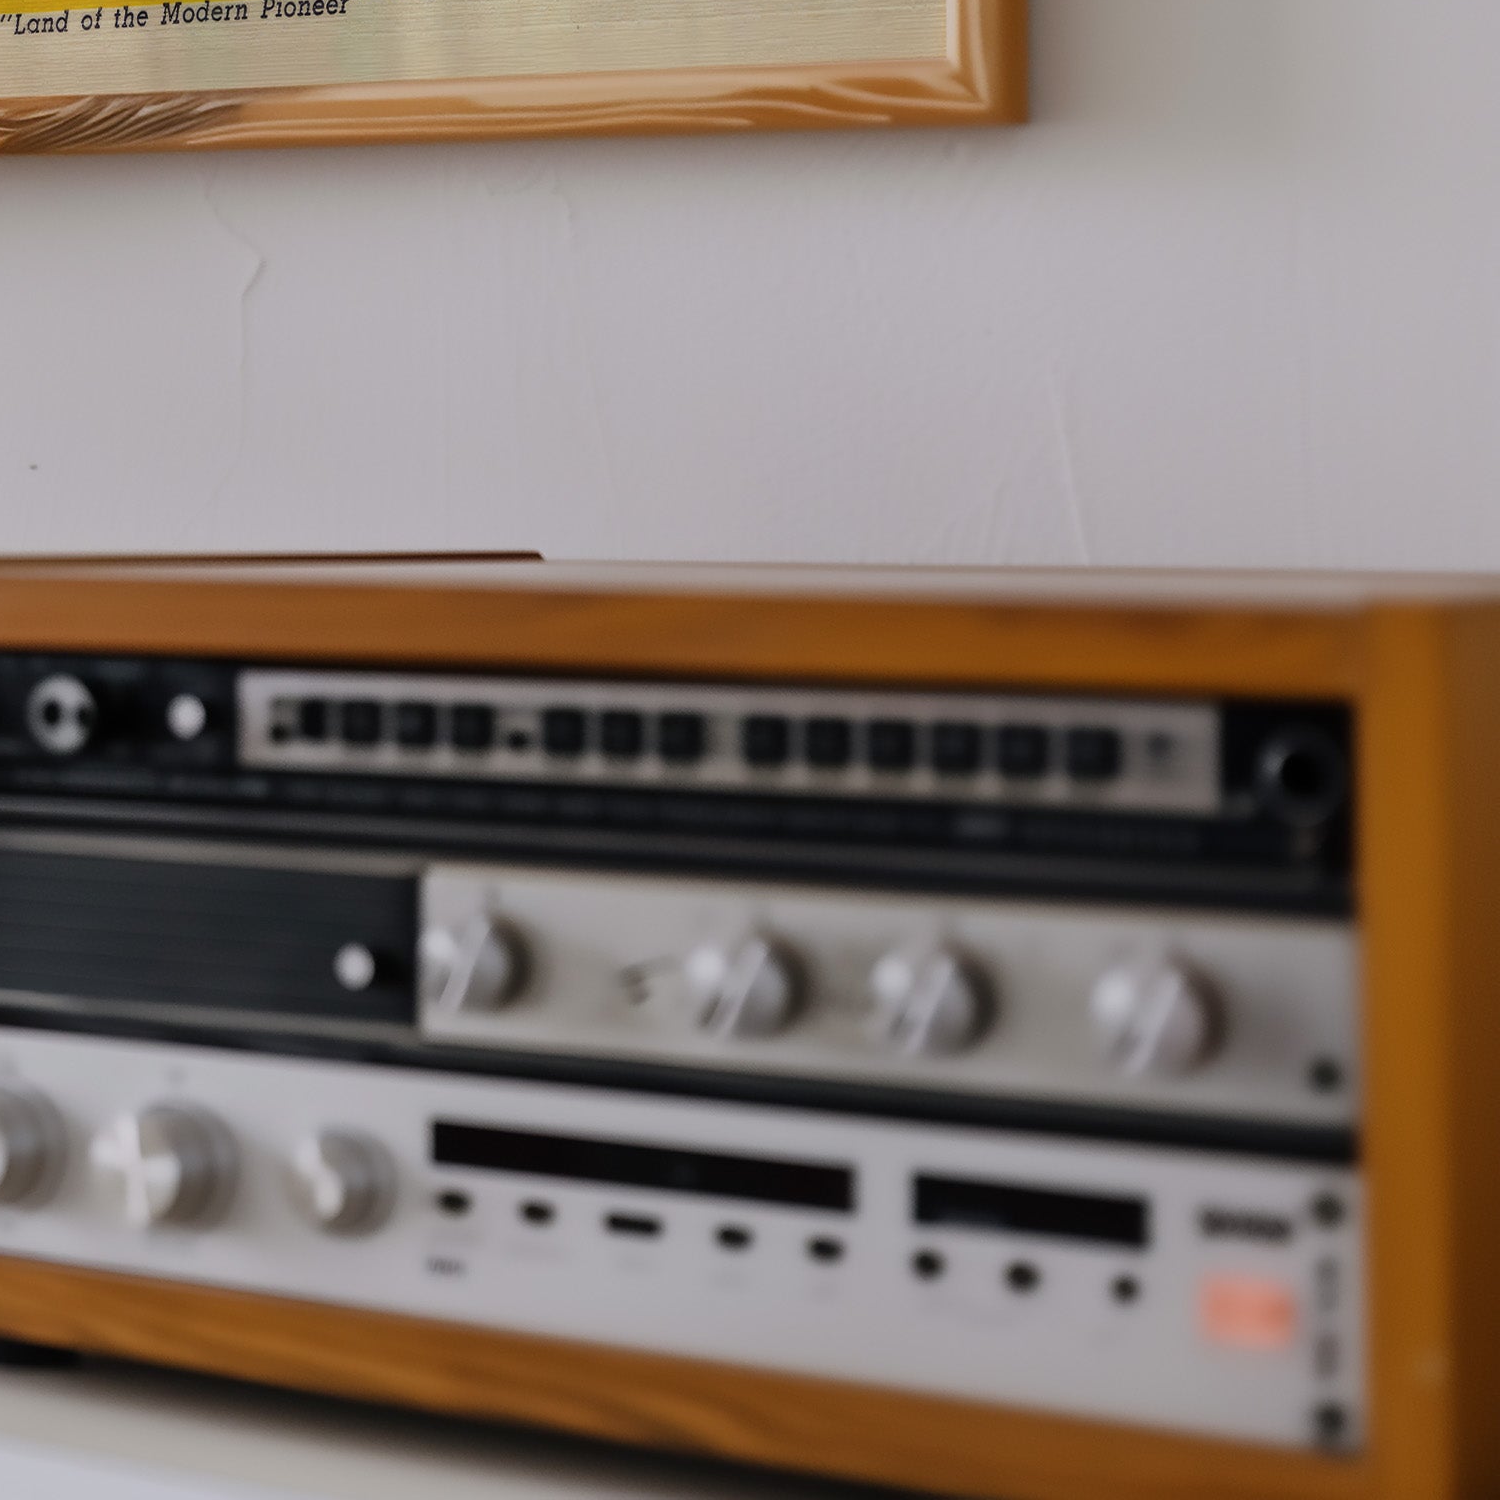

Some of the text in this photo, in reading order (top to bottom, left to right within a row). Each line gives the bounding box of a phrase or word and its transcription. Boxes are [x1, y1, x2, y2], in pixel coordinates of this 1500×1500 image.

[81, 7, 102, 30] of
[114, 5, 149, 29] the
[160, 1, 248, 25] Modern
